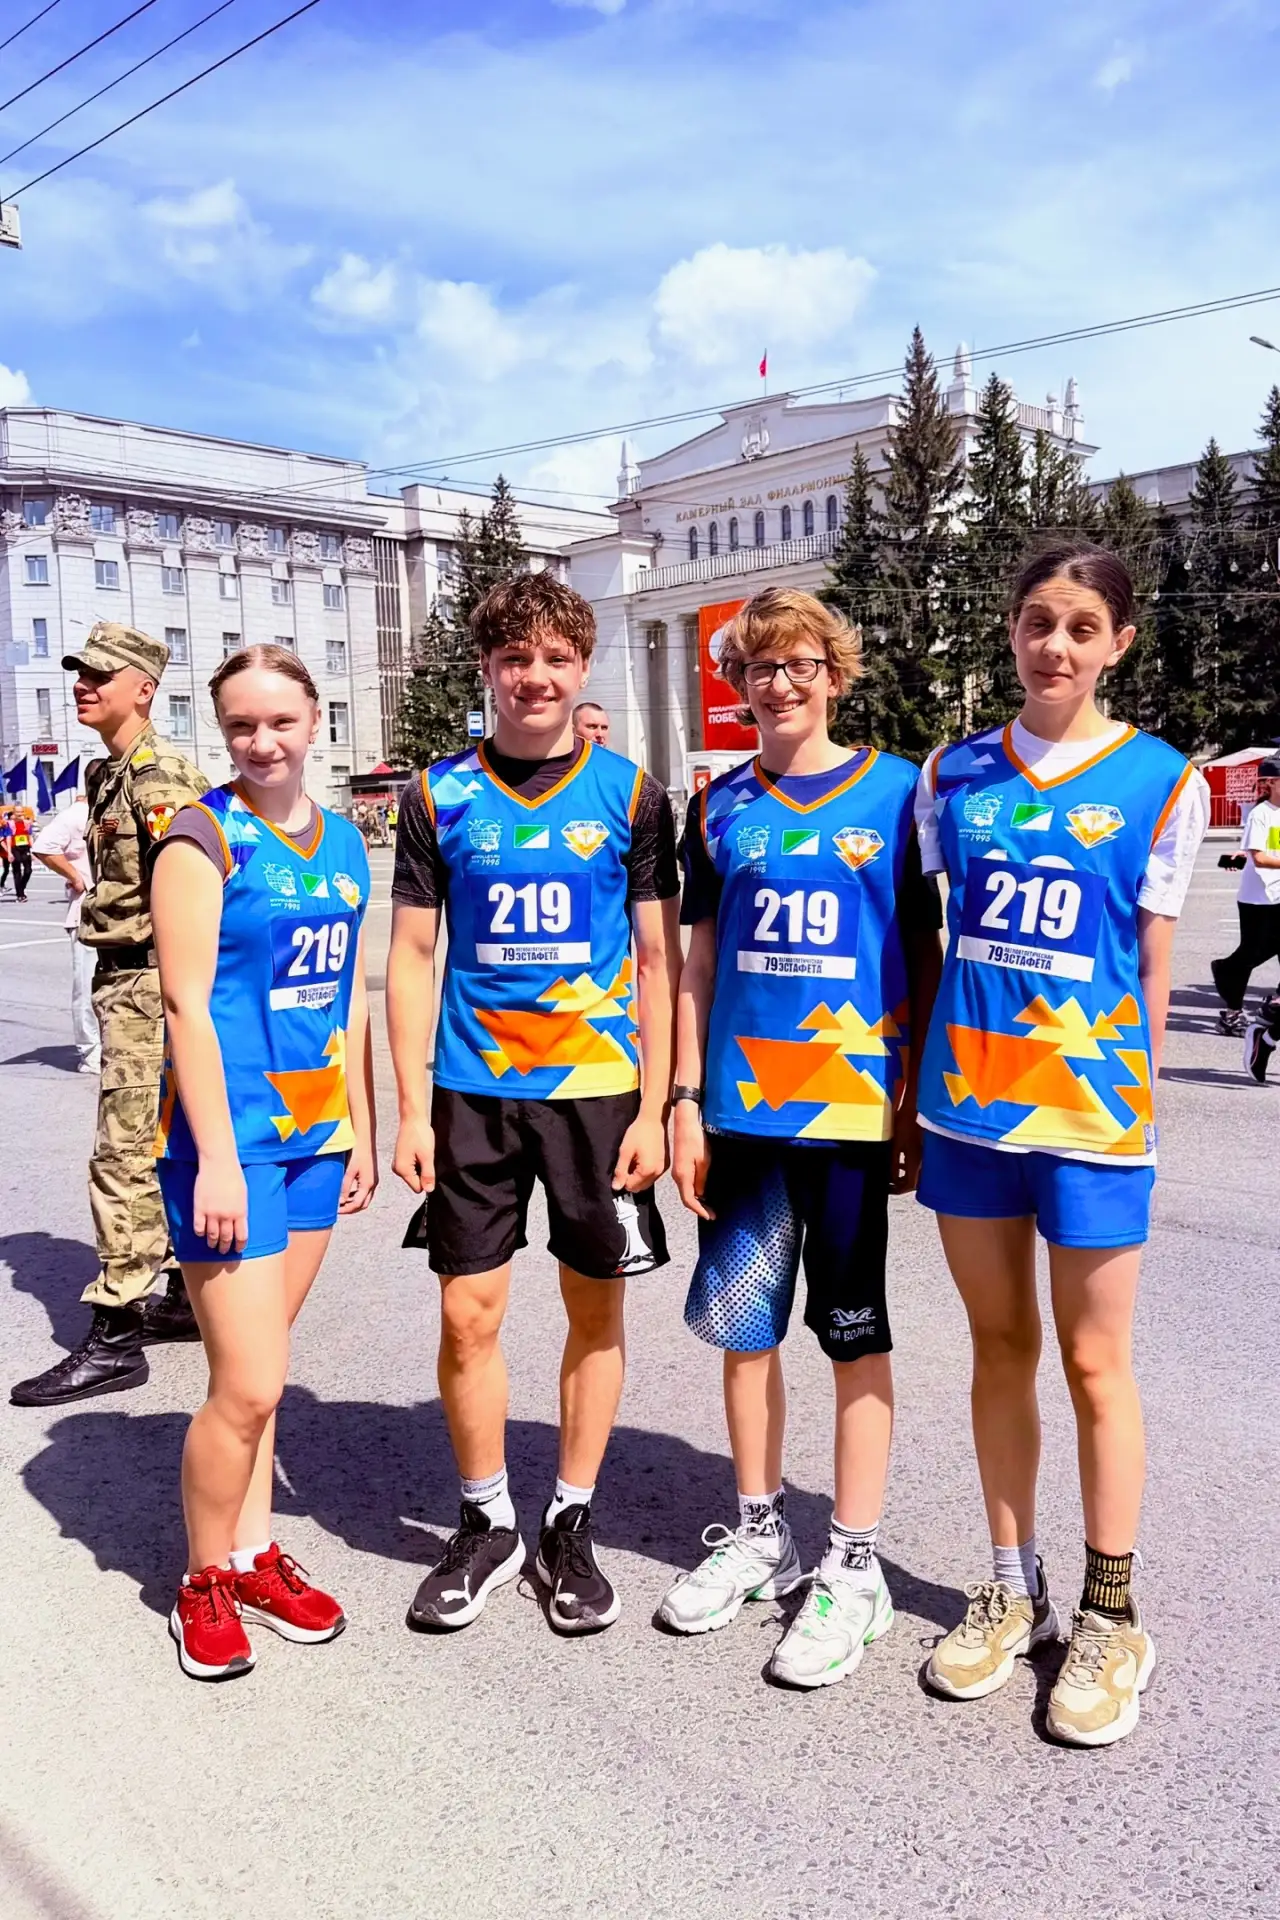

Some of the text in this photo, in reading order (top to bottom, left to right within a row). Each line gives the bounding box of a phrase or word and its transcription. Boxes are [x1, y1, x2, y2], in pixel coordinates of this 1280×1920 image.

[676, 497, 735, 522] КАМЕРНЫЙ
[740, 494, 762, 508] ЗАЛ
[488, 881, 571, 934] 219
[754, 888, 839, 945] 219
[980, 871, 1082, 940] 219
[287, 921, 349, 977] 219
[501, 947, 559, 961] 79 ЭСТАФЕТА
[988, 945, 1052, 970] 79 ЭСТАФЕТА
[764, 957, 822, 974] 79 ЭСТАФЕТА
[296, 989, 307, 1003] 79
[829, 1326, 875, 1342] НА ВОЛНЕ
